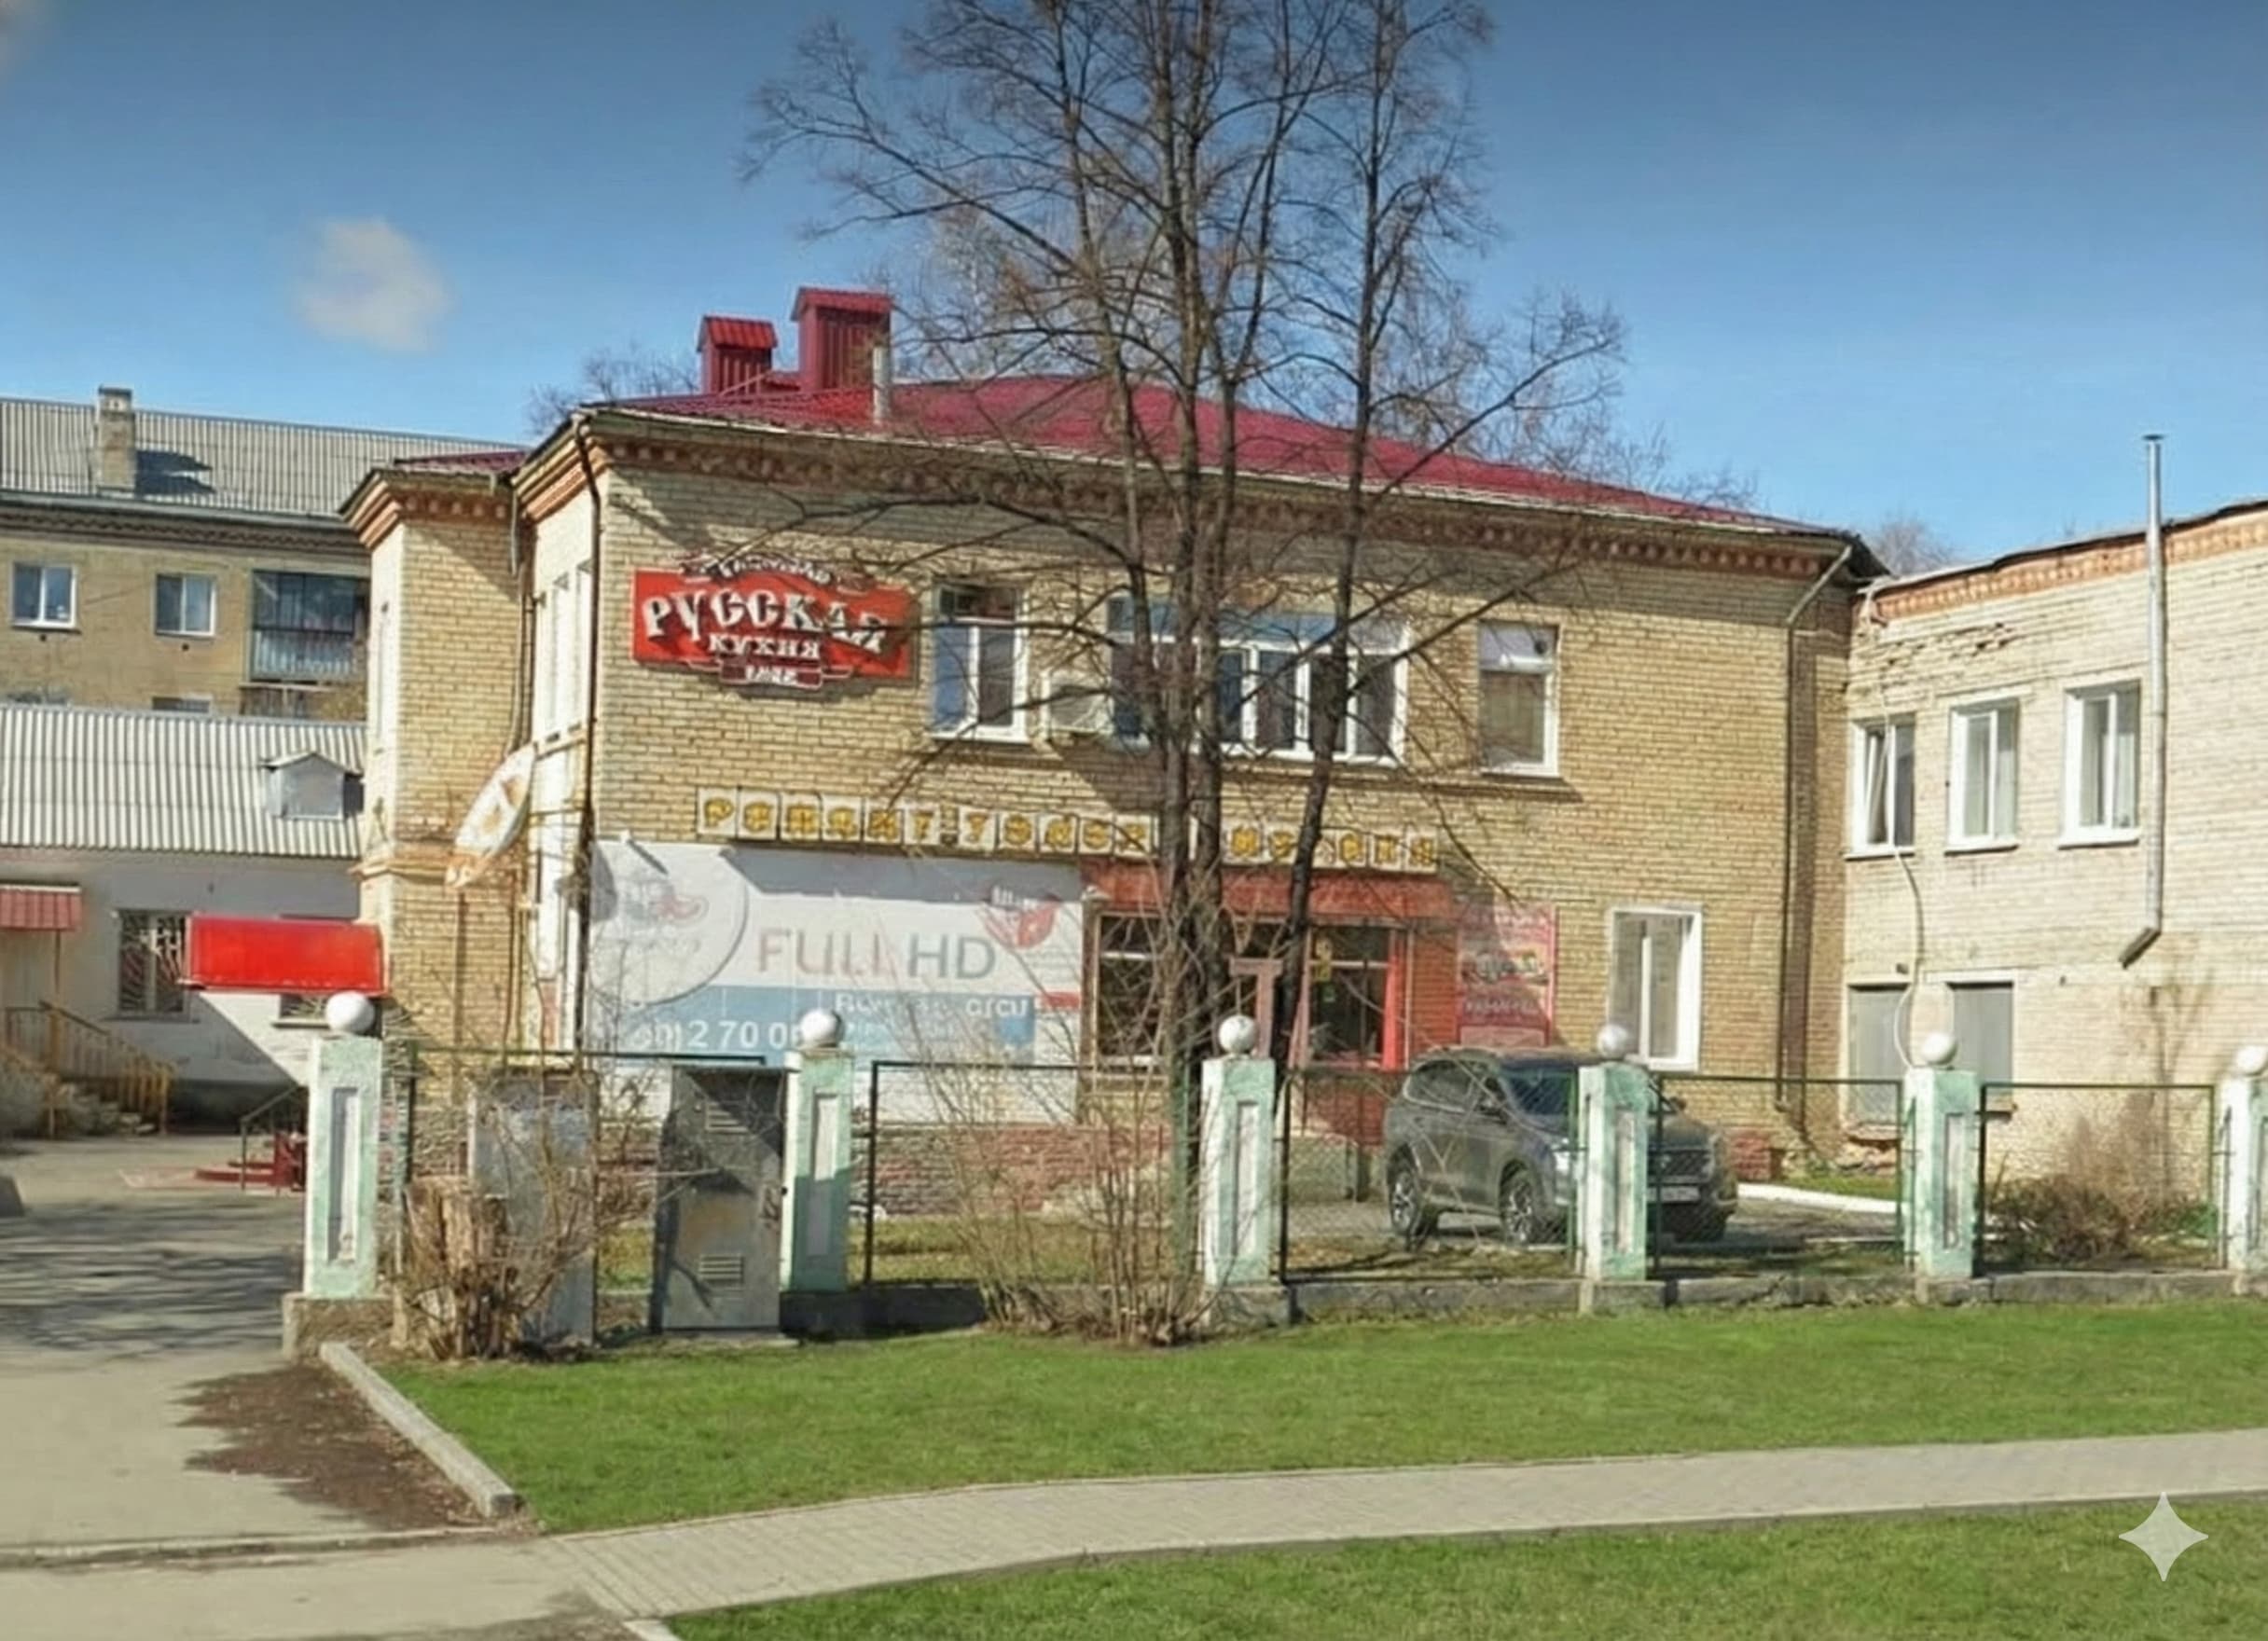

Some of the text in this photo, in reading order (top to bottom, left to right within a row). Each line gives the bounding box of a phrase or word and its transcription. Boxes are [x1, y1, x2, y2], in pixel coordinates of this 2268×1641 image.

[641, 588, 886, 655] РУССКАЯ
[709, 632, 821, 659] КУХНЯ
[907, 932, 997, 980] HD
[687, 1019, 709, 1048] 2
[718, 1021, 758, 1051] 70
